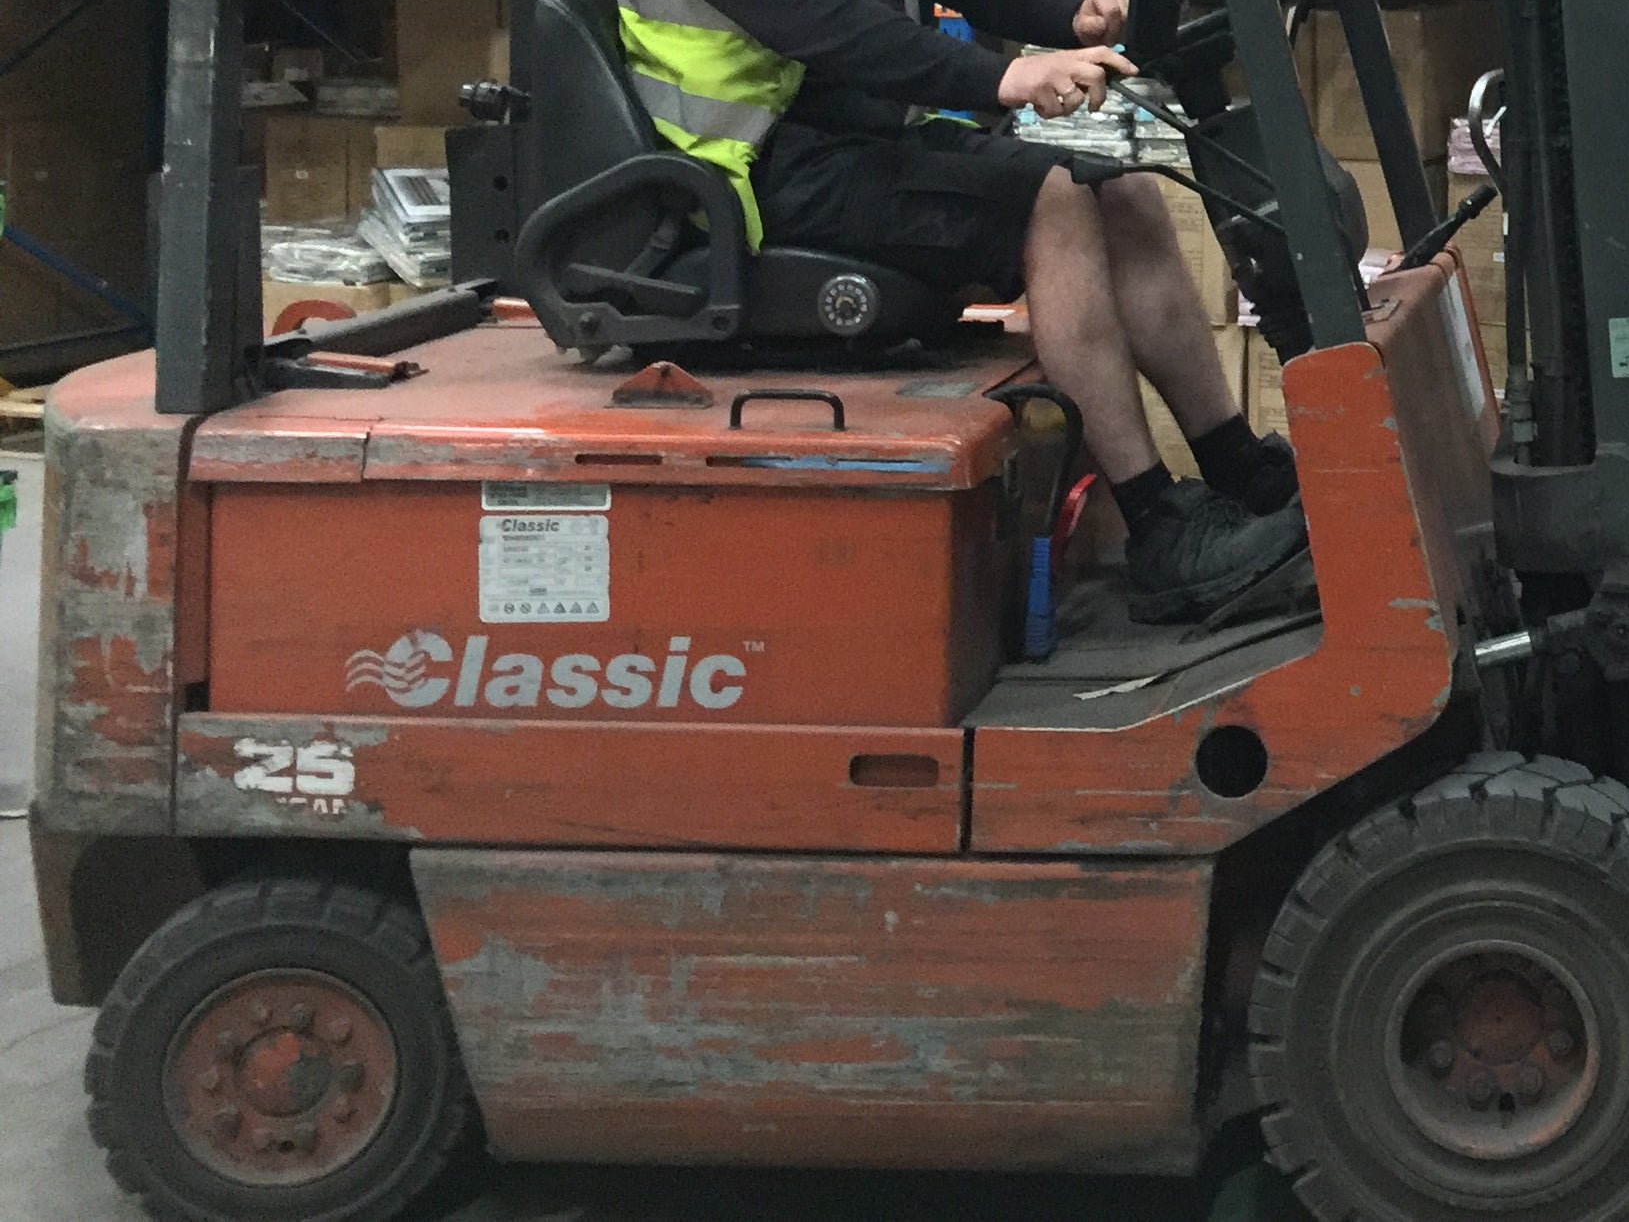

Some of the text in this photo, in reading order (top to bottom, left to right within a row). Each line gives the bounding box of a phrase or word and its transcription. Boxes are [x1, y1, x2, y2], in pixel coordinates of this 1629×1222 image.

[502, 518, 560, 532] Classic
[382, 629, 747, 709] Classic
[233, 737, 355, 796] 25
